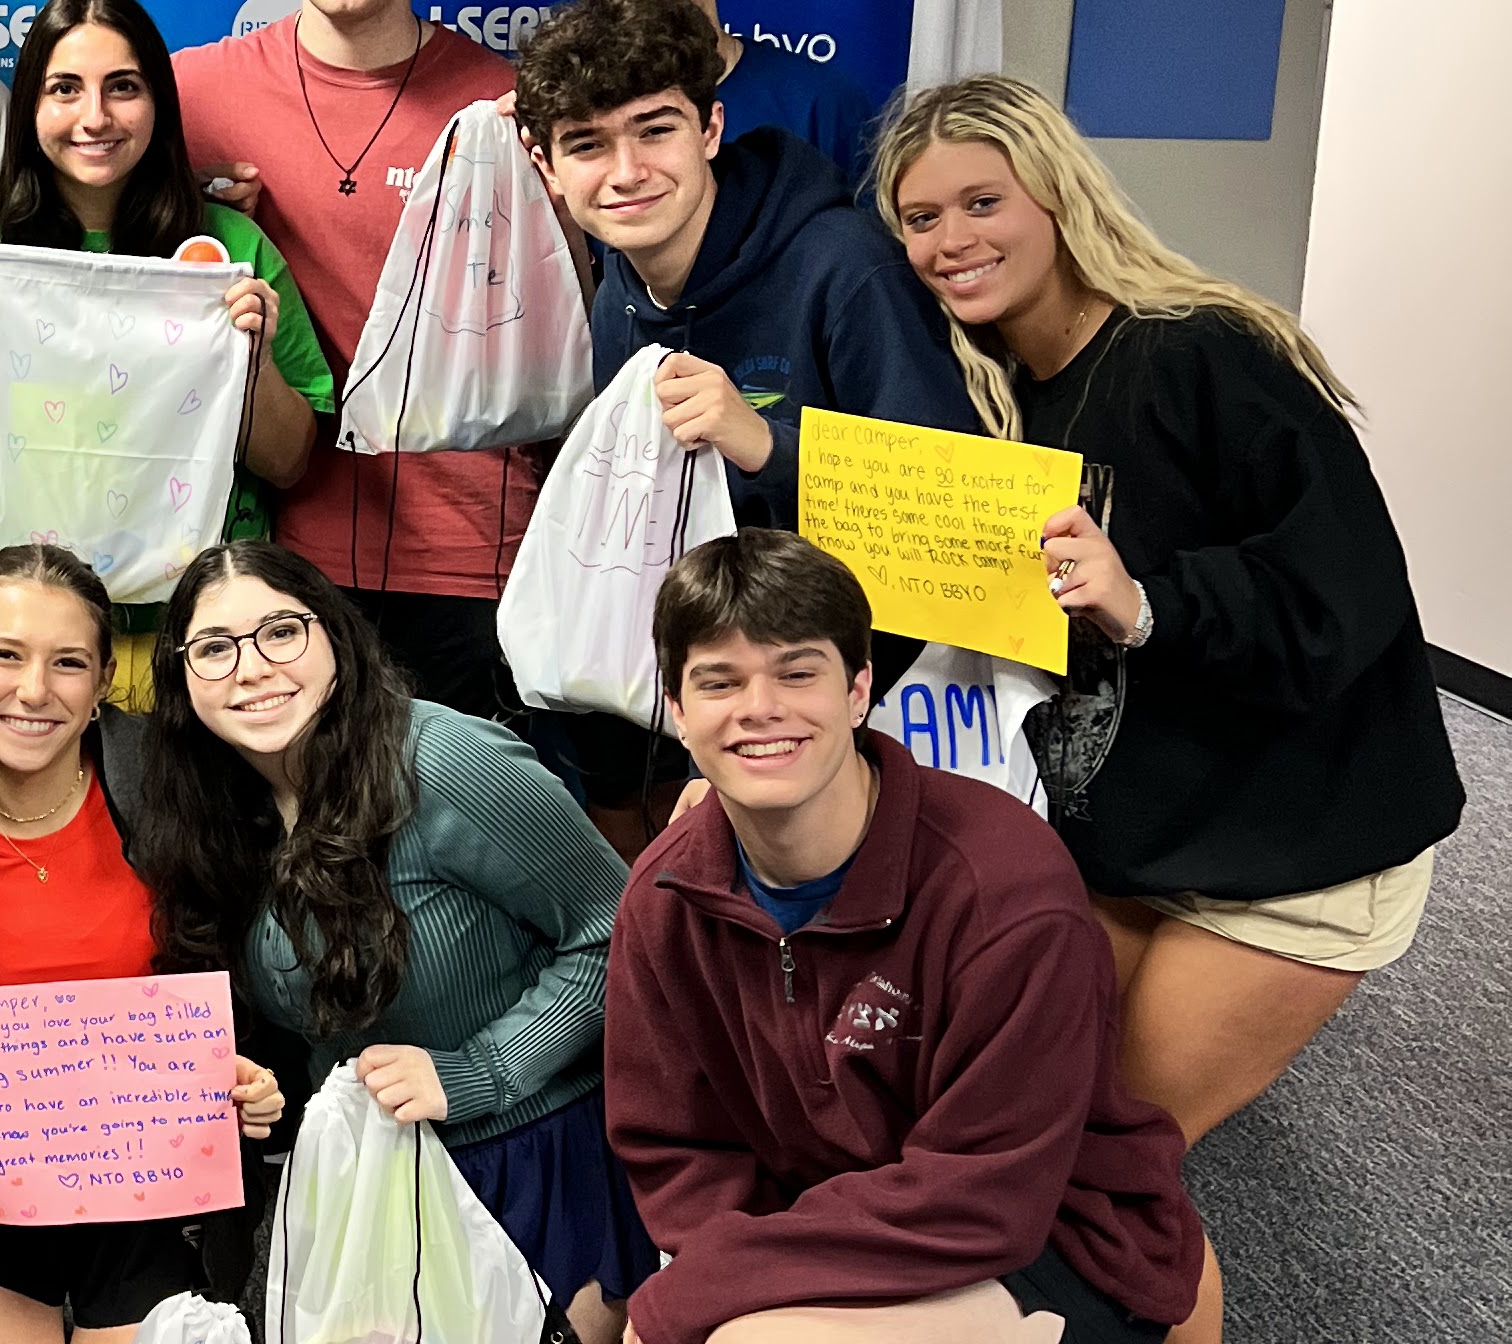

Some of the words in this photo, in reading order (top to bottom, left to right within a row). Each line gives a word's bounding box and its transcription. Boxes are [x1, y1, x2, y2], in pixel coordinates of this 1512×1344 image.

[849, 481, 879, 498] and
[885, 485, 911, 506] you
[915, 486, 954, 508] have
[963, 494, 990, 513] the
[996, 498, 1039, 522] best
[940, 582, 987, 602] BBYO
[1, 1022, 30, 1039] you
[43, 1018, 72, 1028] love
[80, 1014, 116, 1030] your
[128, 1011, 157, 1027] bag
[165, 1001, 212, 1020] filled
[0, 1039, 48, 1056] things
[57, 1033, 90, 1048] and
[101, 1032, 146, 1045] have
[154, 1029, 197, 1043] such
[203, 1027, 228, 1039] an
[128, 1054, 157, 1072] You
[168, 1060, 197, 1072] are
[24, 1098, 65, 1111] have
[79, 1096, 98, 1107] an
[110, 1088, 192, 1106] incredible
[42, 1123, 88, 1142] you're
[100, 1120, 145, 1137] going
[151, 1116, 168, 1126] to
